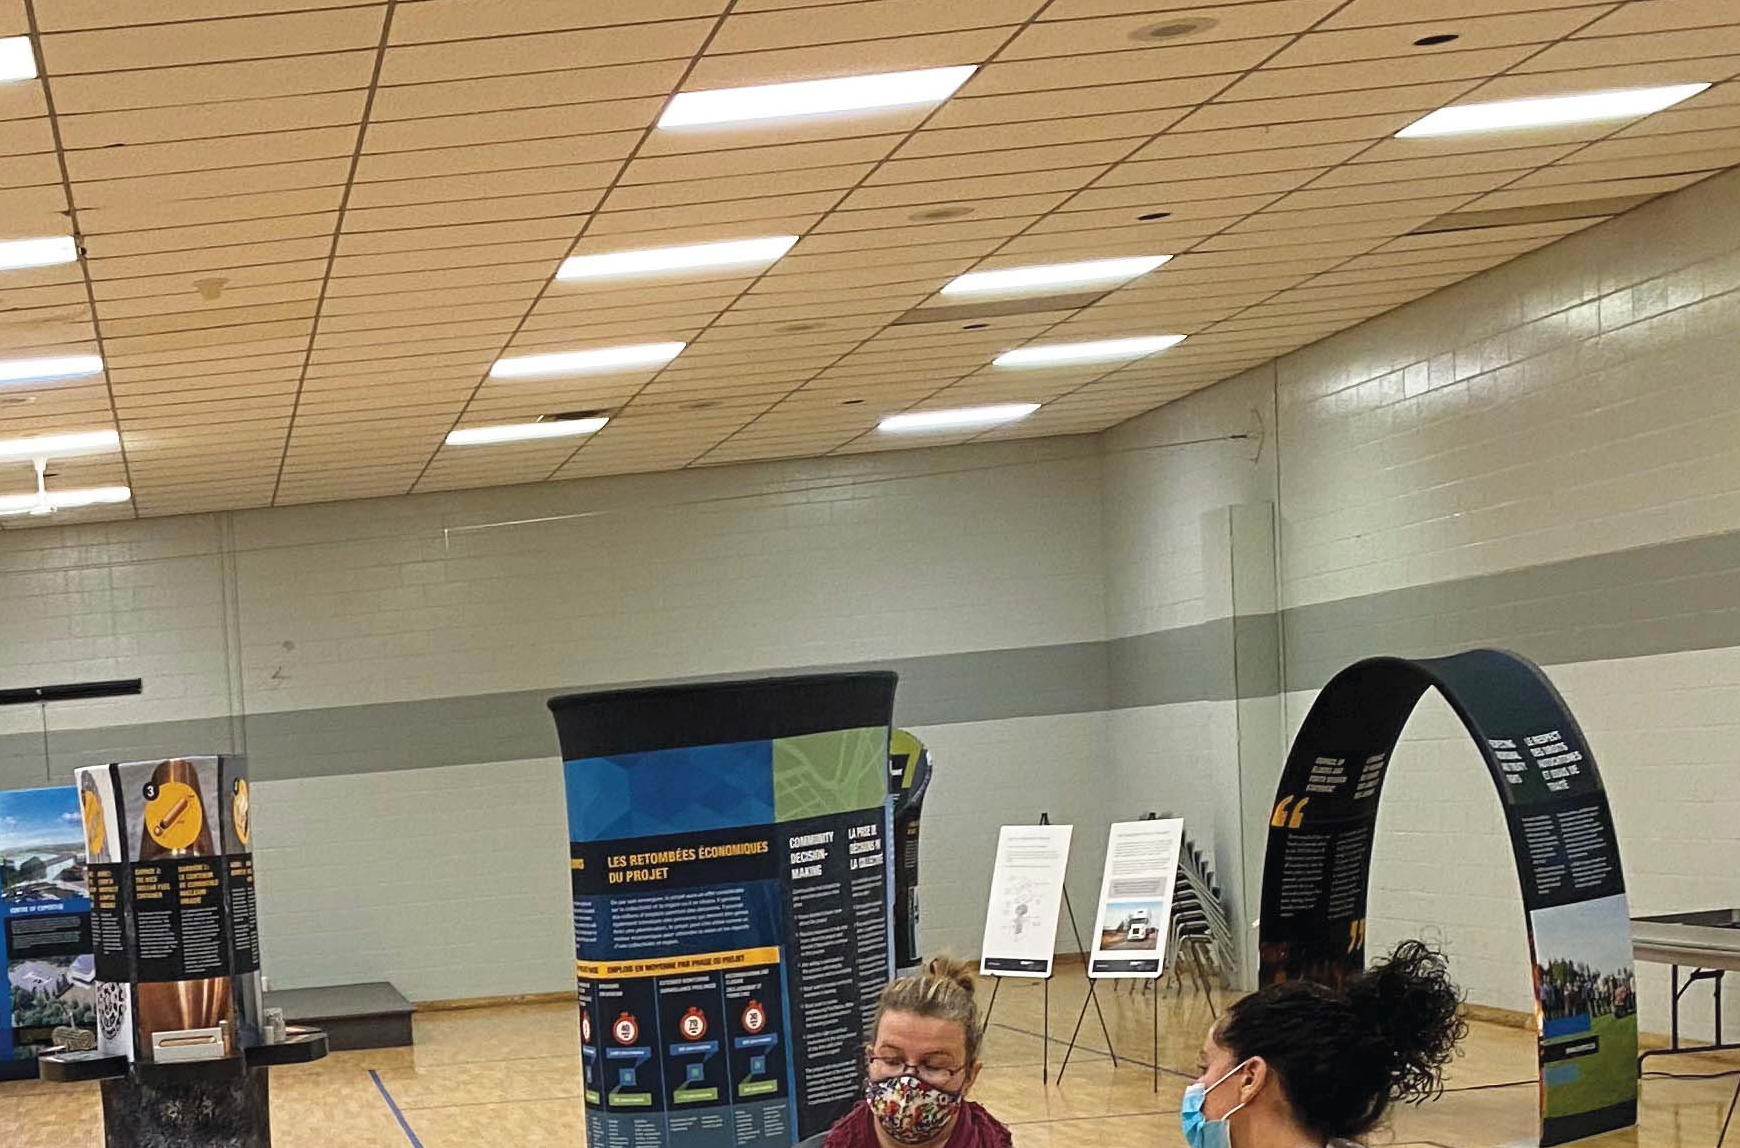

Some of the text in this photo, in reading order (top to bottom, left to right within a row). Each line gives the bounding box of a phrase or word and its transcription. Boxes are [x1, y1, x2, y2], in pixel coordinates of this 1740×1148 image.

[1532, 730, 1562, 745] RESPECT
[147, 785, 155, 797] 3
[789, 831, 835, 849] COMMUNITY
[848, 827, 857, 840] LA
[607, 855, 627, 869] LES
[630, 847, 697, 867] RETOMBÉES
[698, 841, 769, 860] ÉCONOMIQUES
[790, 848, 829, 865] DECISION-
[609, 867, 669, 884] DU PROJET
[791, 864, 823, 880] MAKING
[722, 954, 746, 964] PROJET
[689, 1019, 698, 1028] 70
